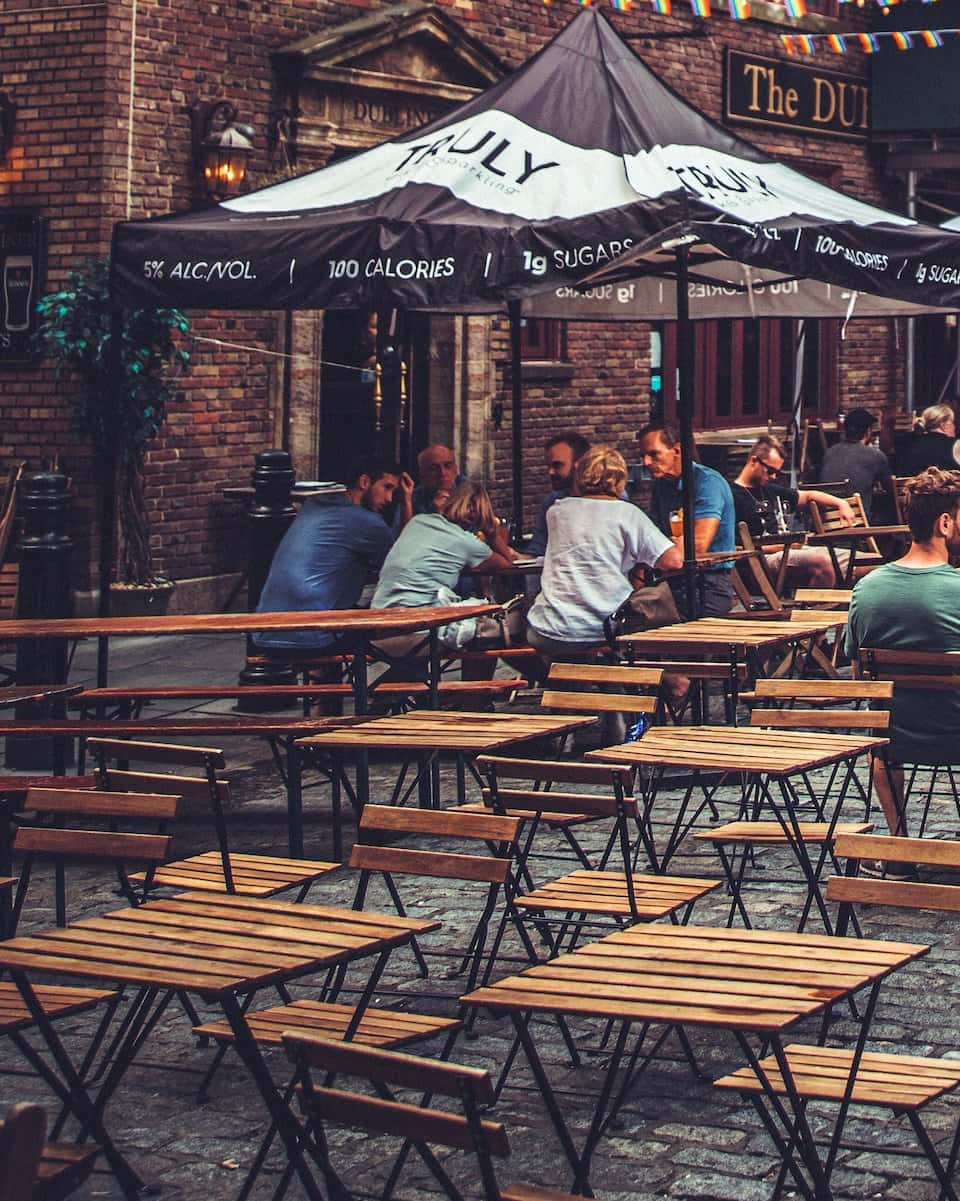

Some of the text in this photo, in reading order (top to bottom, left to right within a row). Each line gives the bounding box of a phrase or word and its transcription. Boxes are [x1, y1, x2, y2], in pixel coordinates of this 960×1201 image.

[744, 64, 799, 118] The
[395, 127, 561, 185] TRULY
[143, 260, 165, 279] 5%
[328, 260, 360, 279] 100
[365, 257, 456, 280] CALORIES
[523, 250, 548, 275] 1g
